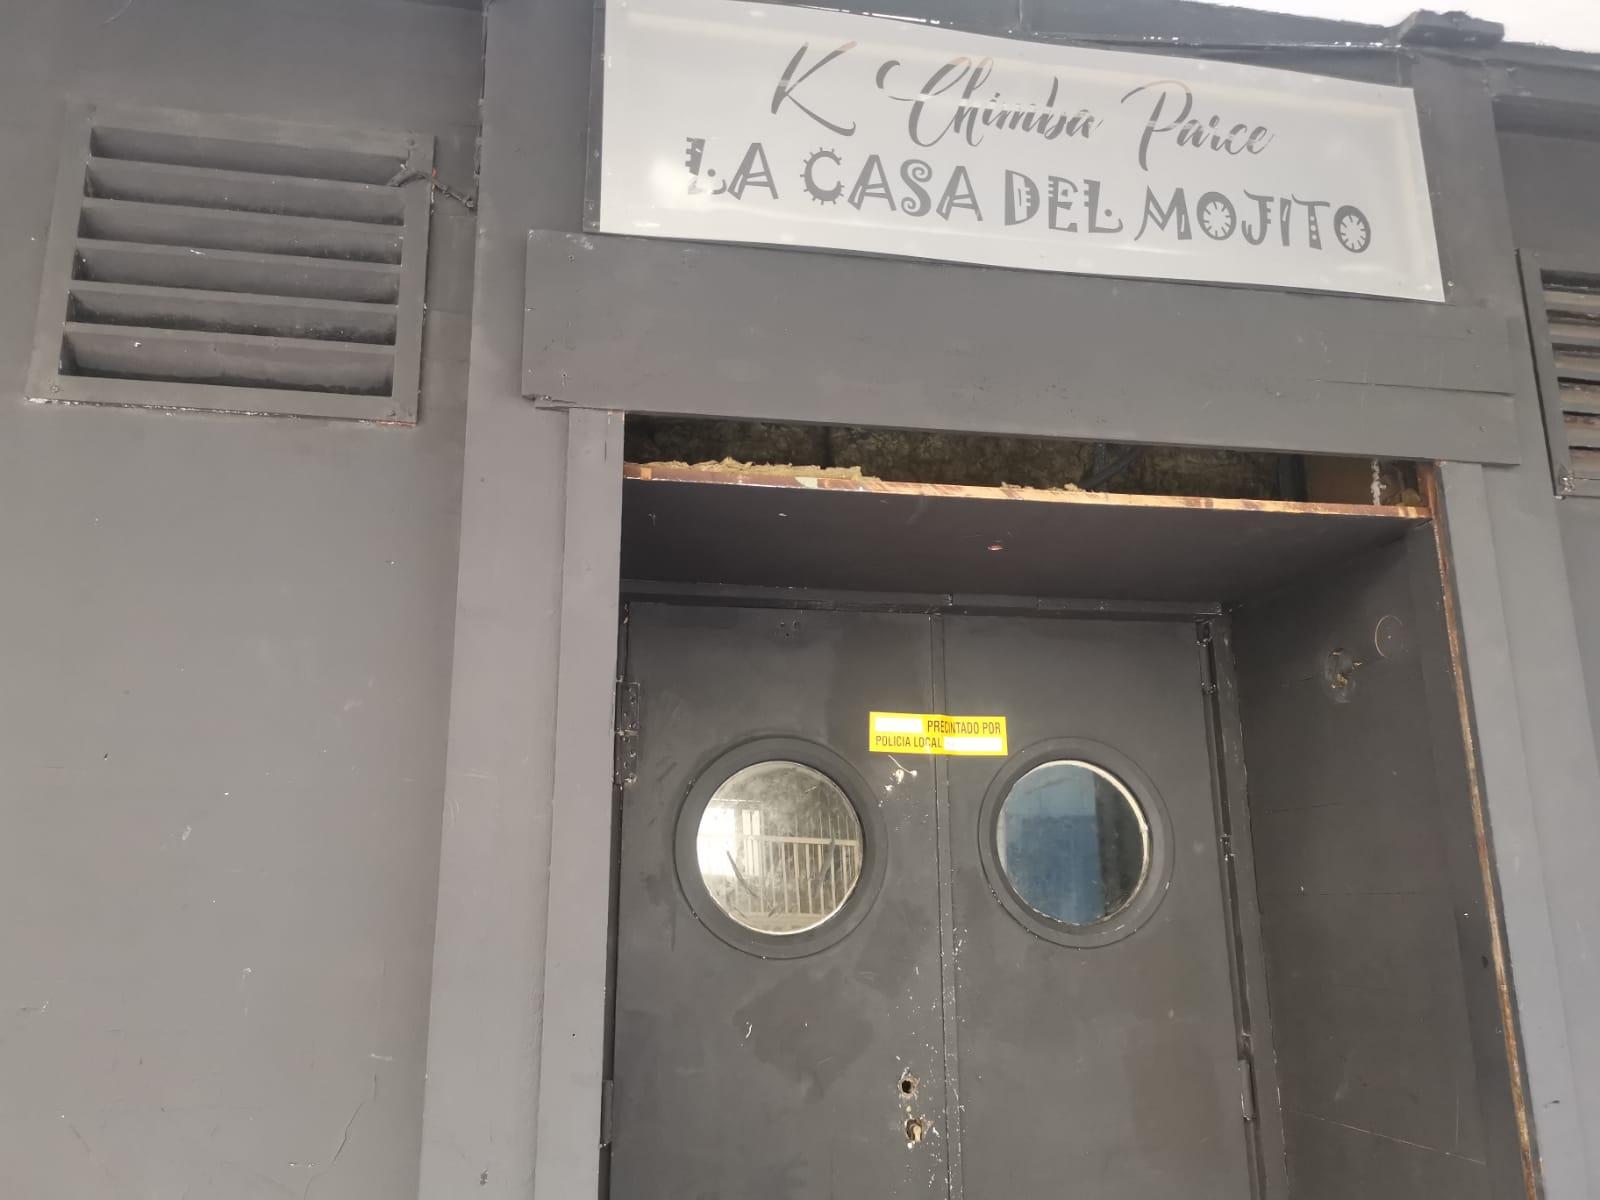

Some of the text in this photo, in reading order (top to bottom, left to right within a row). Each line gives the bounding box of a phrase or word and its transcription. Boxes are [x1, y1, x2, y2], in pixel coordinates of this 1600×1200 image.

[770, 41, 1277, 172] K Chimba Parce
[684, 136, 1372, 254] LA CASA DEL MOJITO
[875, 735, 943, 749] POLICIA LOCAL
[927, 720, 1001, 735] PRECINTADO POR
